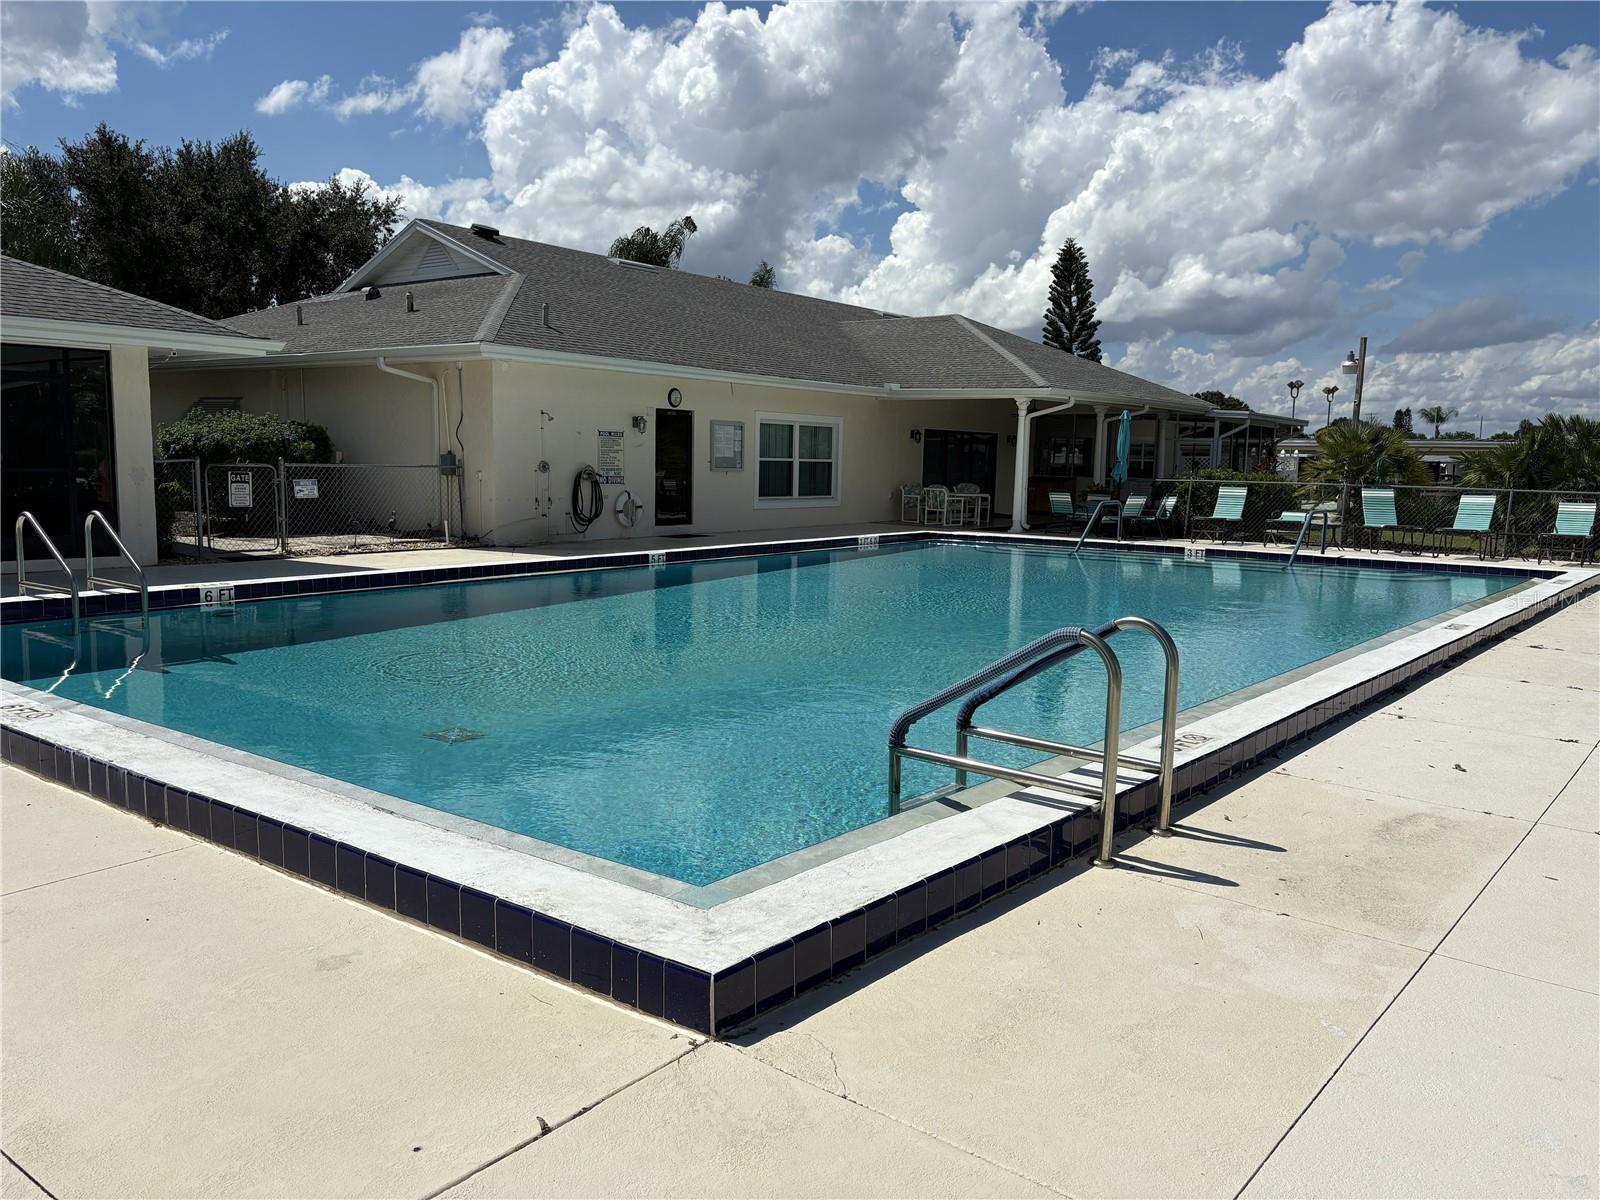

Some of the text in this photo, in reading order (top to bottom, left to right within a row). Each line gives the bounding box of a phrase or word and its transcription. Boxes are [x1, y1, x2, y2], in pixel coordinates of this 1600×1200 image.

[230, 474, 250, 482] GATE
[204, 588, 234, 602] 6 FT
